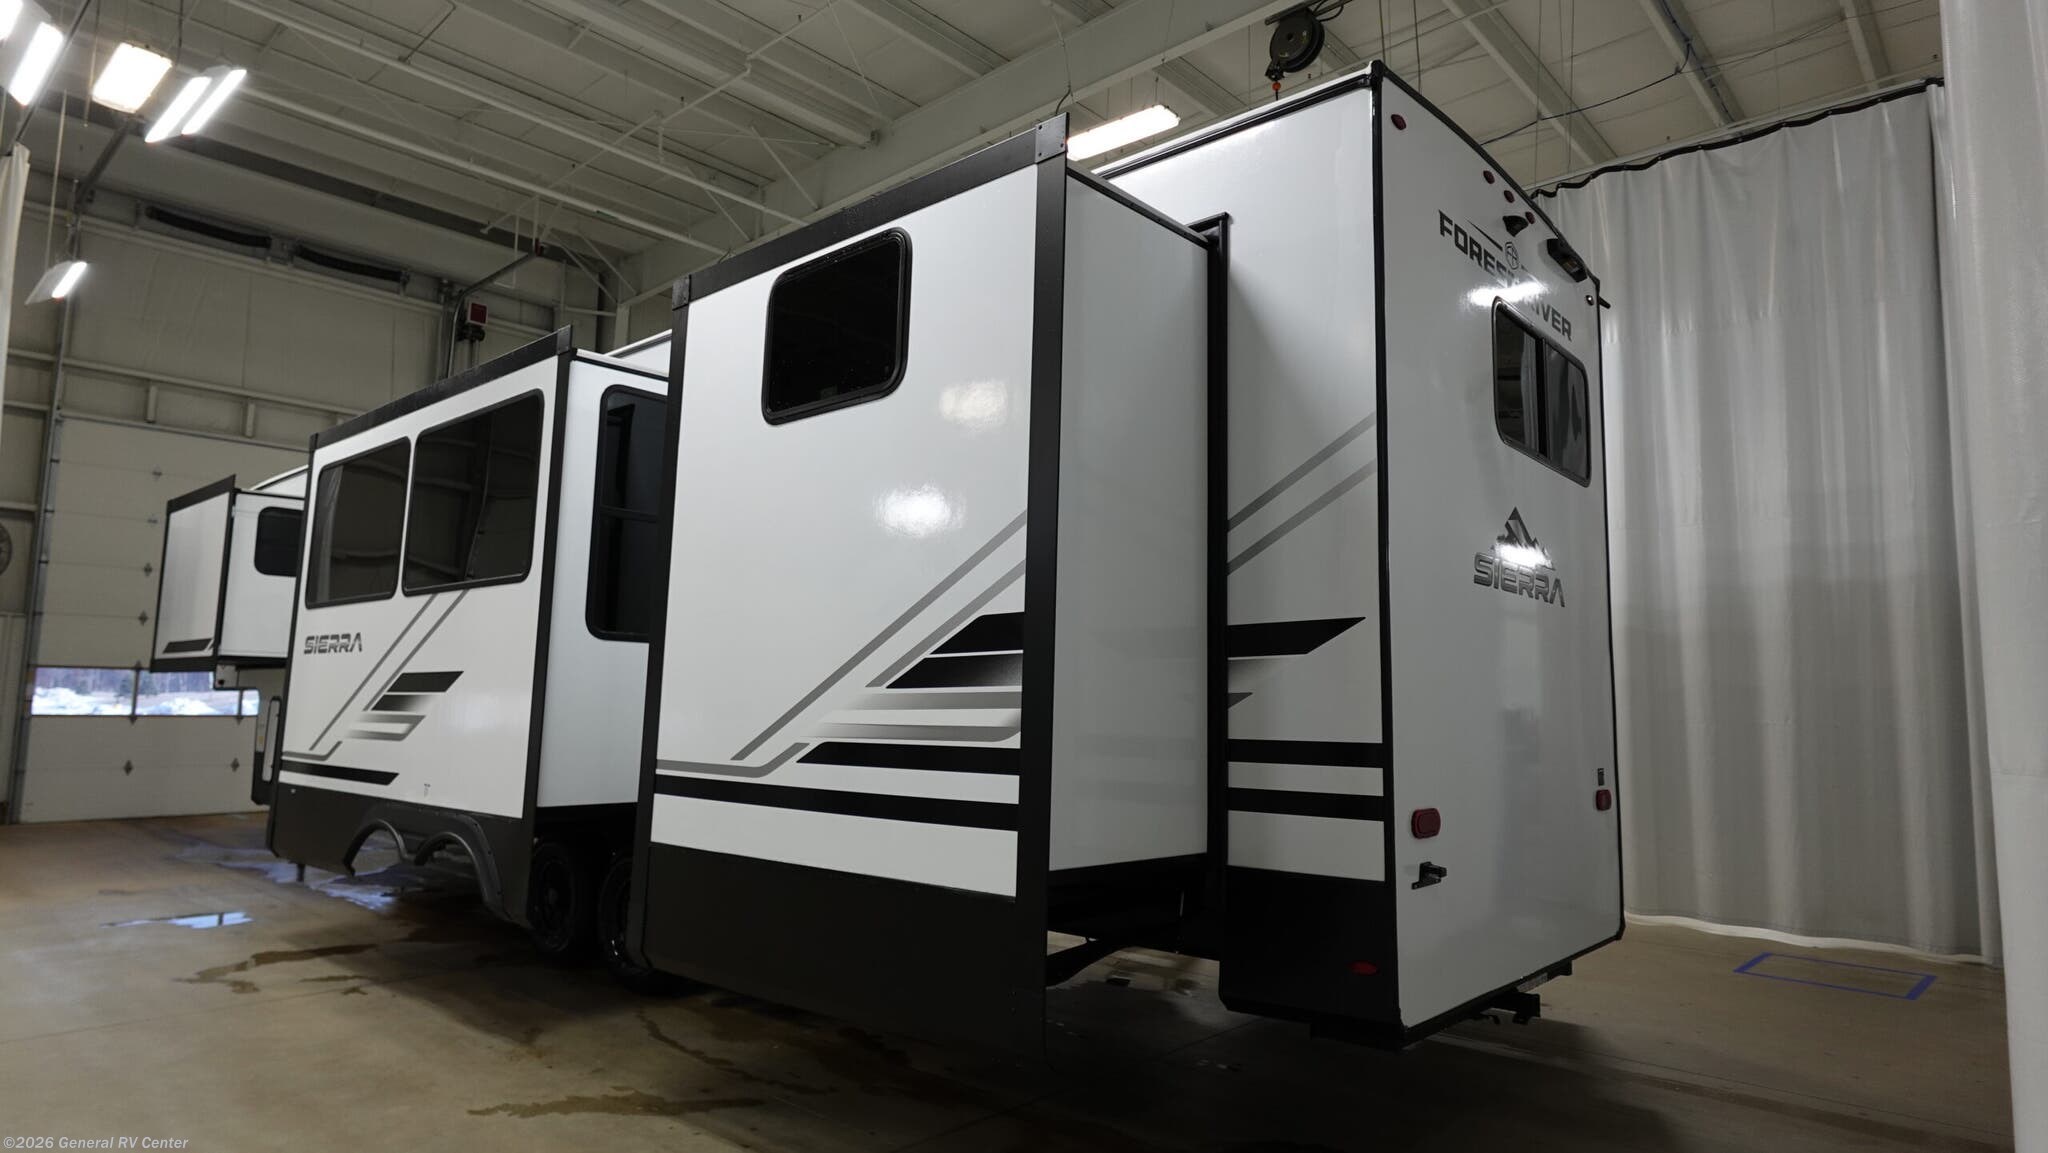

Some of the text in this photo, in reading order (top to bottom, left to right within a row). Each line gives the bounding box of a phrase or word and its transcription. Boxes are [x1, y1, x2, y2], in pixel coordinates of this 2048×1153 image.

[1525, 291, 1573, 343] IVER
[1473, 551, 1566, 608] SIERRA
[304, 632, 363, 654] SIERRA
